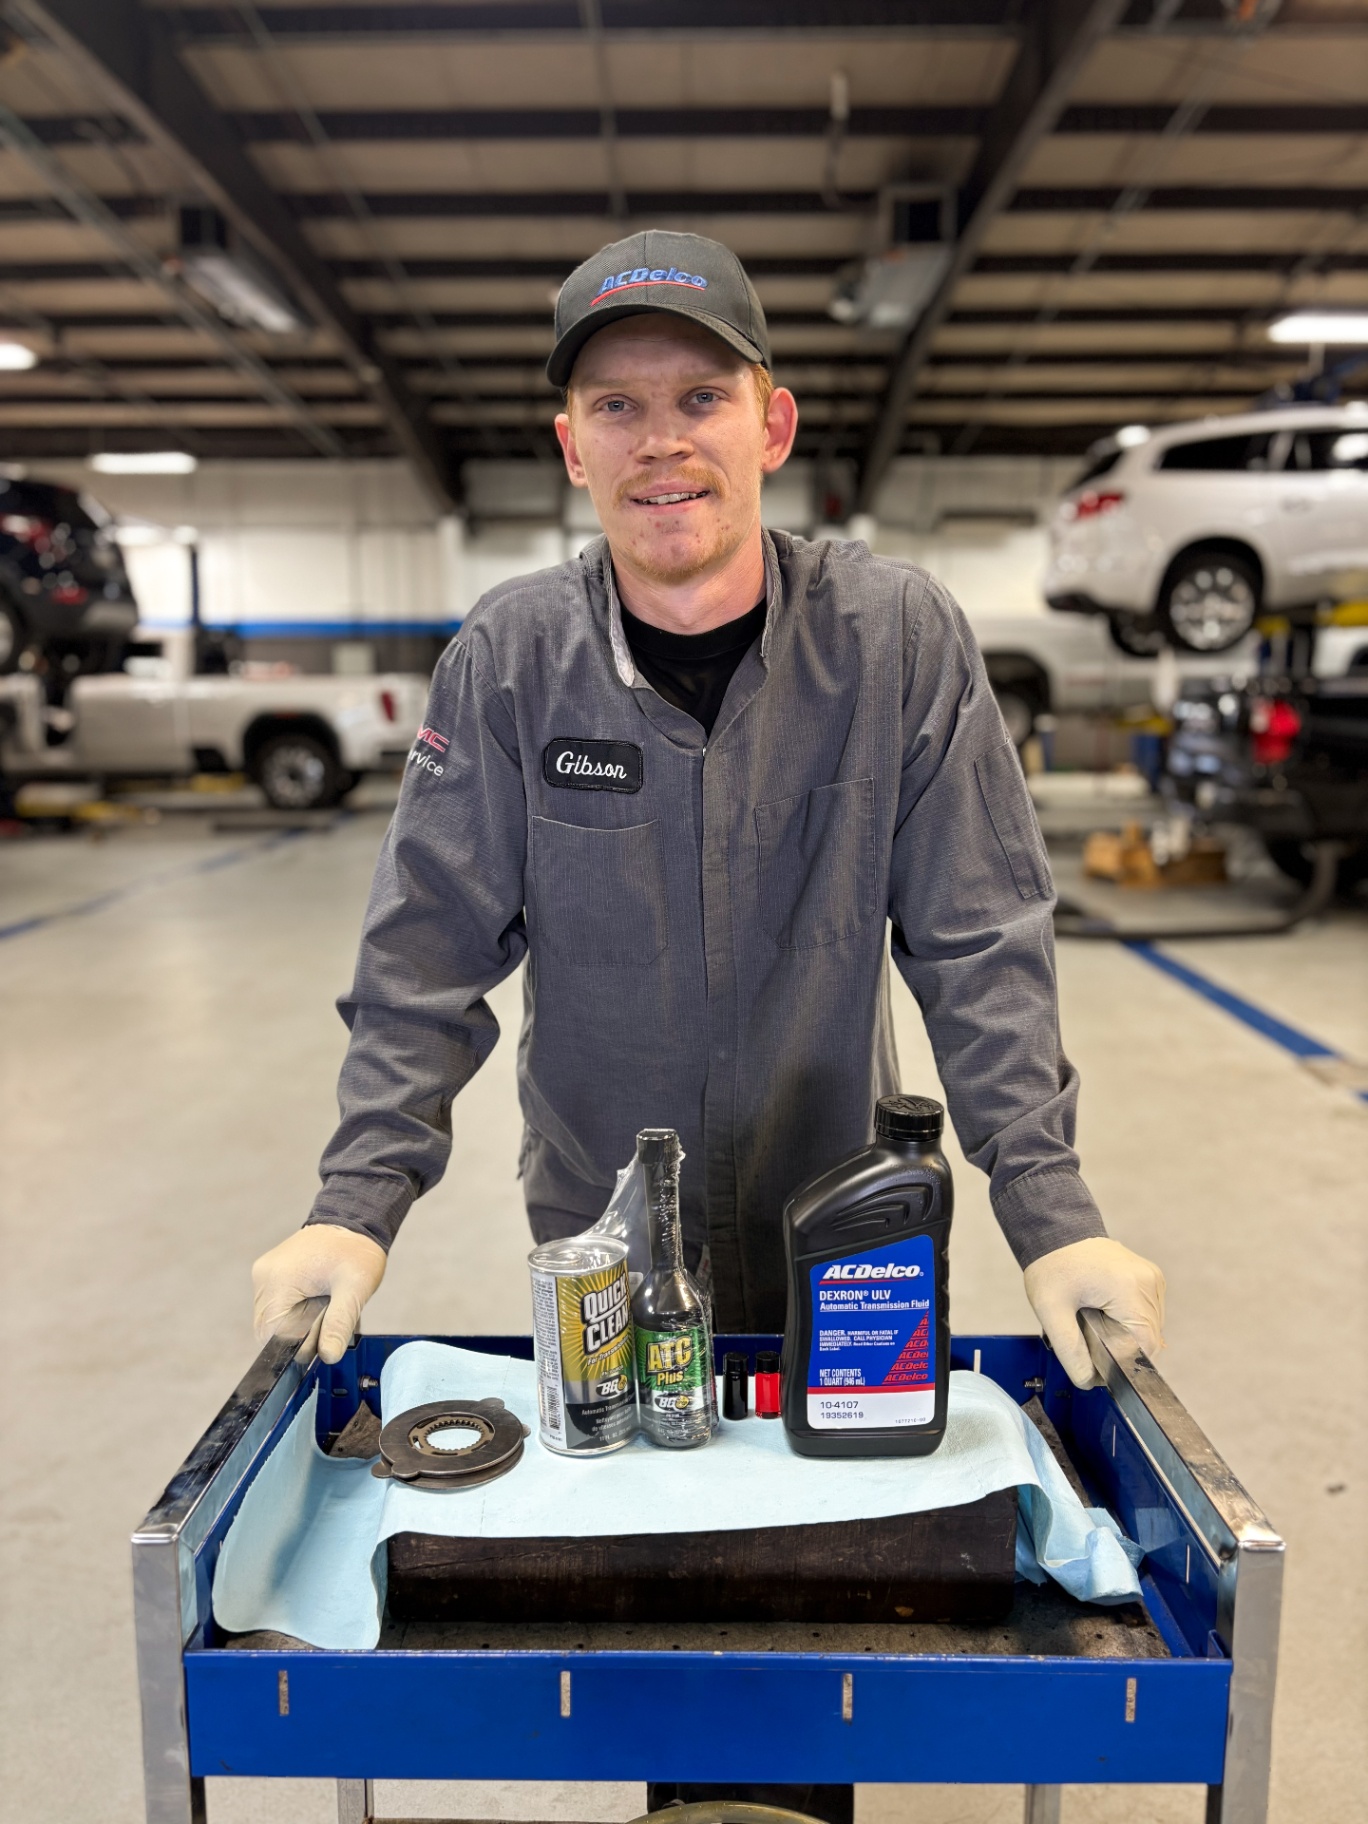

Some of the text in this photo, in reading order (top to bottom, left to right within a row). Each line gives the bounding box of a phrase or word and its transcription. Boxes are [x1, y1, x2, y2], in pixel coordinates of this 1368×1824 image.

[597, 267, 708, 298] ACDelco
[417, 725, 450, 753] MC
[408, 750, 444, 777] rvice
[556, 751, 627, 779] Gibson
[822, 1263, 921, 1279] ACDelco
[584, 1272, 627, 1324] QUICK
[872, 1290, 891, 1300] ULV
[820, 1299, 930, 1310] Automatic Transmission Fluid
[587, 1300, 629, 1352] CLEAN
[649, 1336, 692, 1371] ATC
[657, 1371, 684, 1386] Plus
[820, 1368, 861, 1377] NET CONTENTS
[884, 1372, 929, 1381] ACDelco
[601, 1379, 619, 1396] BG
[824, 1377, 843, 1386] QUART
[820, 1401, 859, 1409] 10-4107
